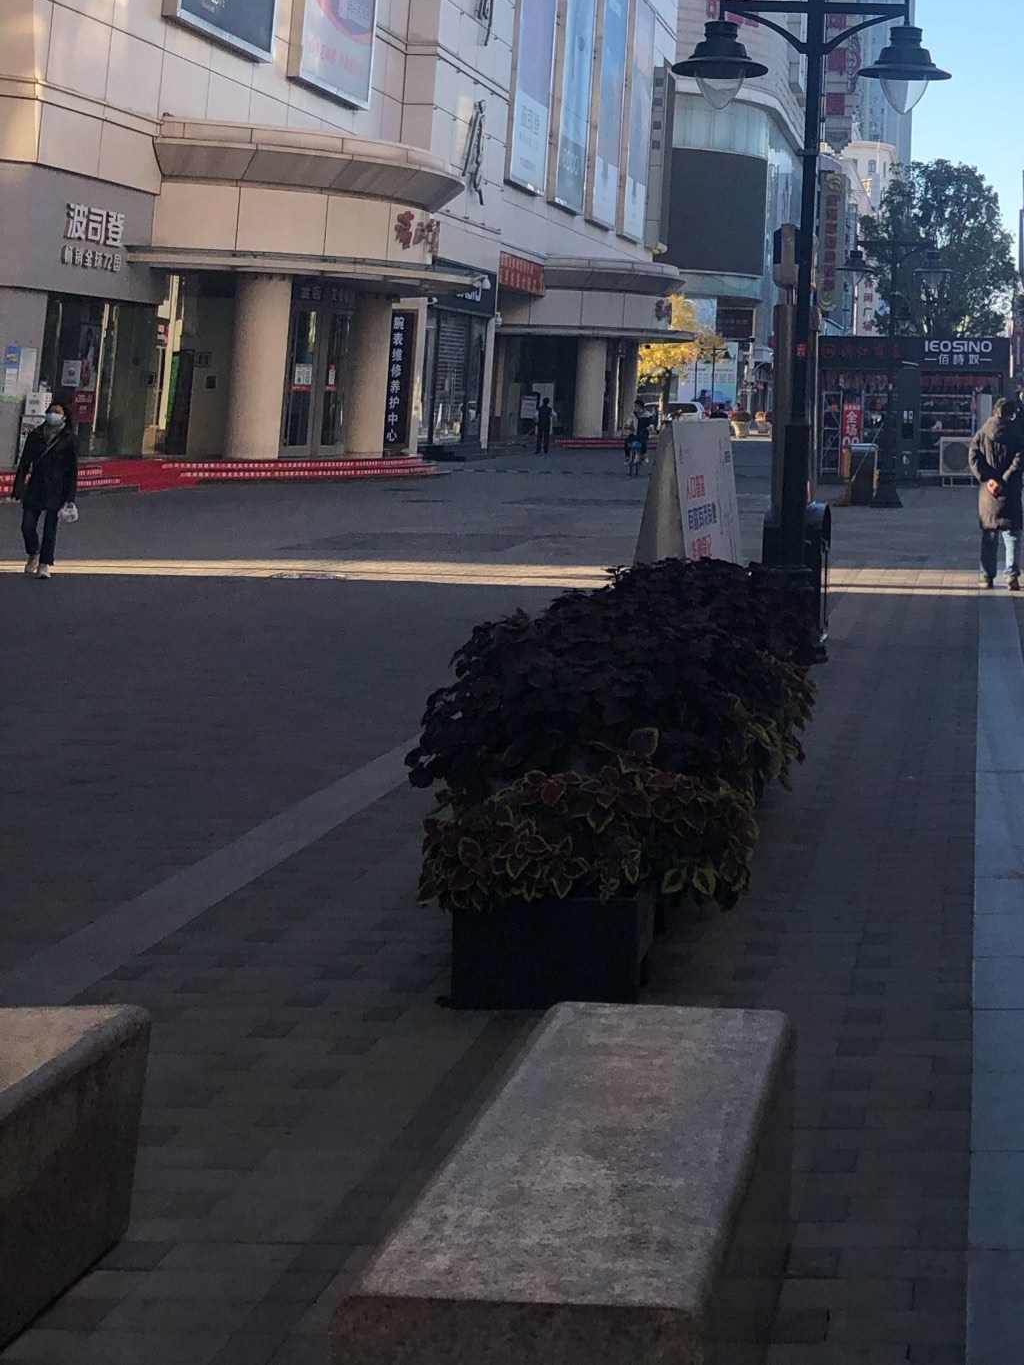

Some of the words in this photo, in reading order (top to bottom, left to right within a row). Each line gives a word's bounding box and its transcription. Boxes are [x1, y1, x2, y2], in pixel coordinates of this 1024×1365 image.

[66, 203, 126, 247] 波司登
[386, 316, 405, 442] 腕表维修养护中心
